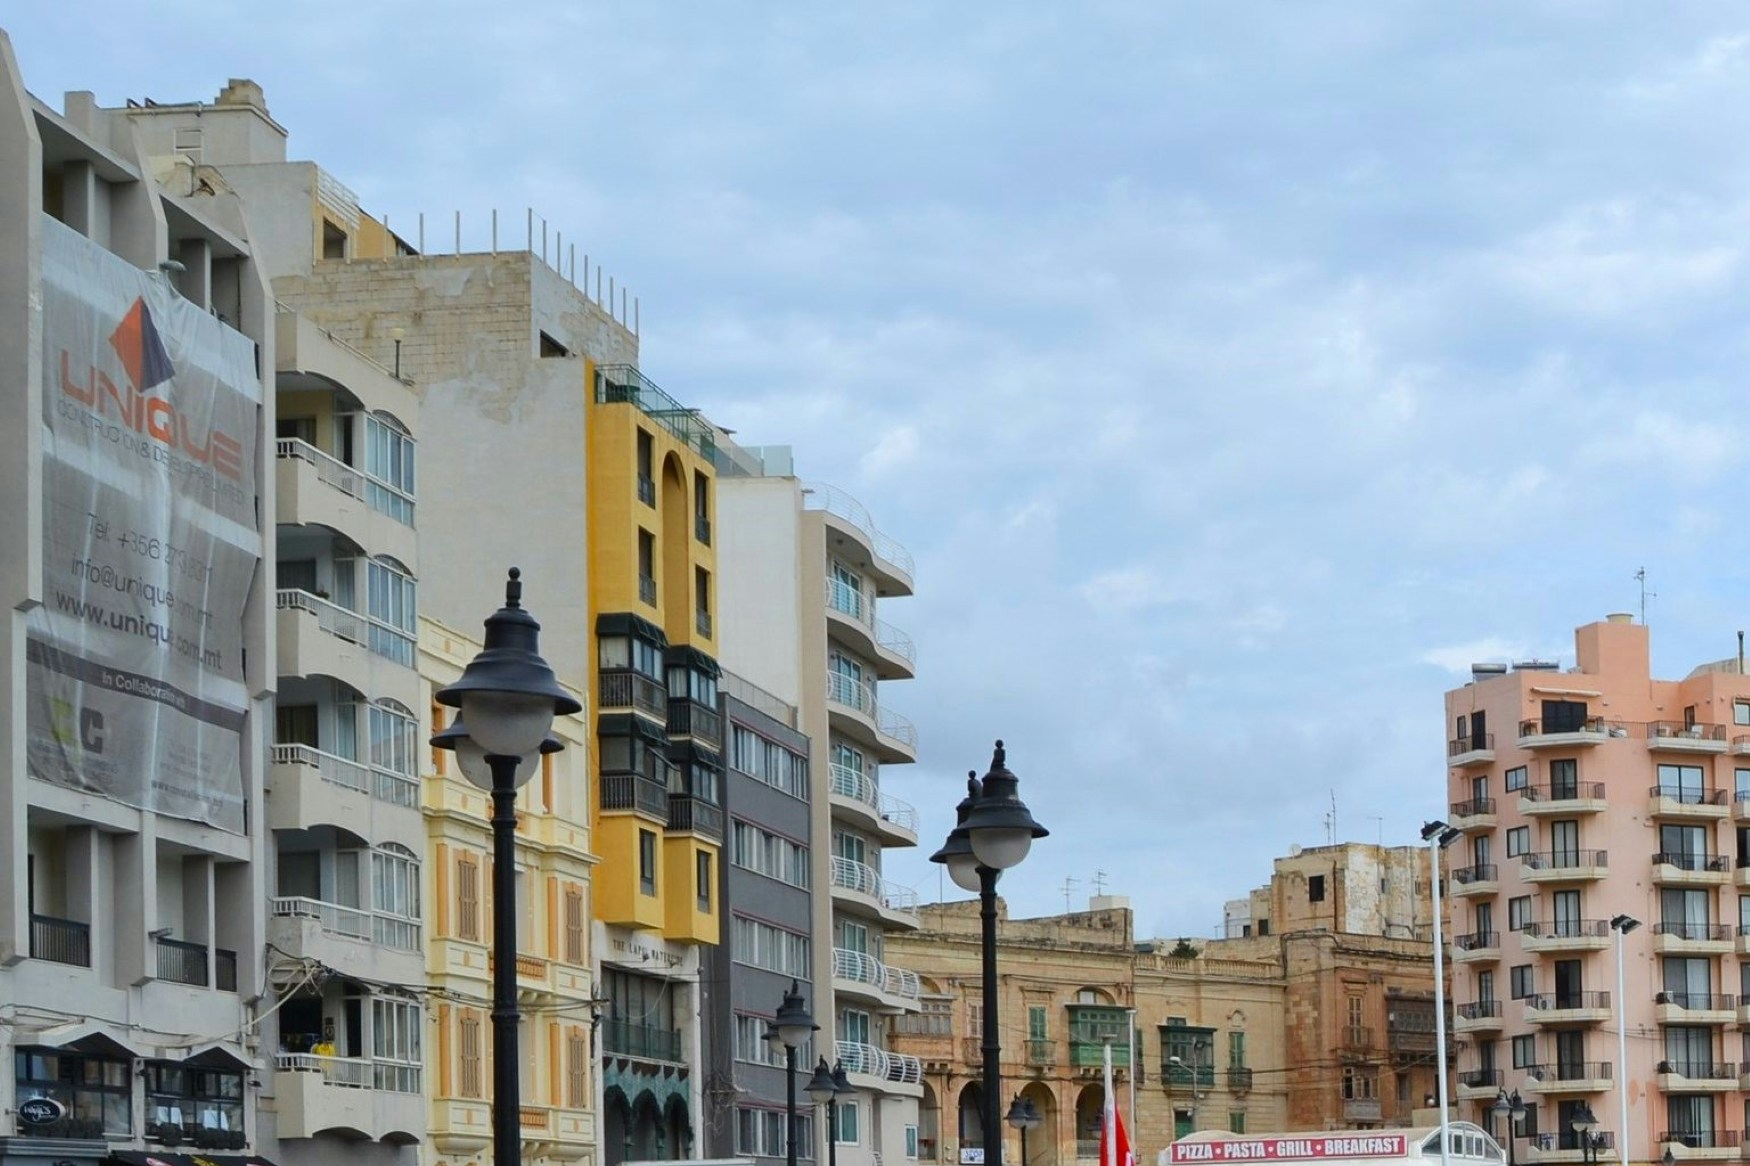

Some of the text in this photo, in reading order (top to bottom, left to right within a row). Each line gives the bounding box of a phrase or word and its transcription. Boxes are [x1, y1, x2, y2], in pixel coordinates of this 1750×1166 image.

[61, 350, 241, 481] UNIQUE
[56, 591, 222, 670] www.uniqucom.mt
[1177, 1138, 1400, 1160] PIZZA PASTA GRILL BREAKFAST
